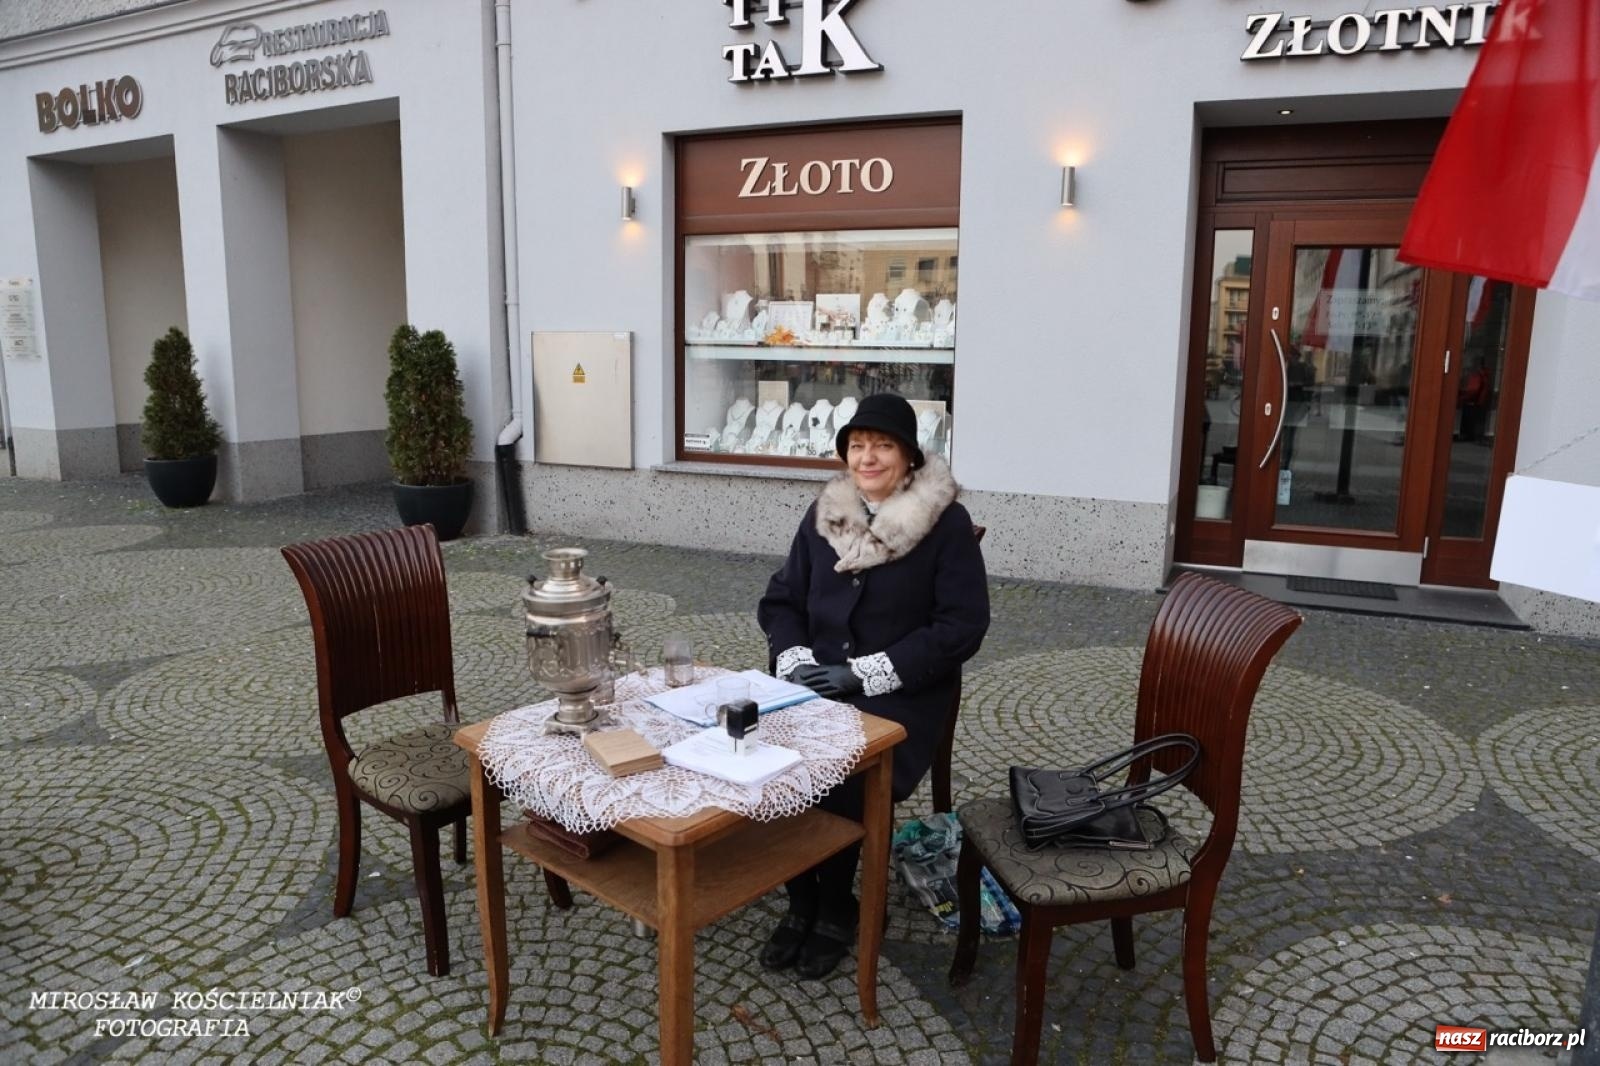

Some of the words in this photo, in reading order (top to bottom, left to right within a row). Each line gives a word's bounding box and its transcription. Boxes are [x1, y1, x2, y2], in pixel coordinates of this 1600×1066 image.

[262, 9, 390, 57] RESTAURACJA
[225, 50, 374, 105] RACIBORSKA
[35, 75, 143, 134] BOLKO
[737, 156, 894, 199] ZŁOTO
